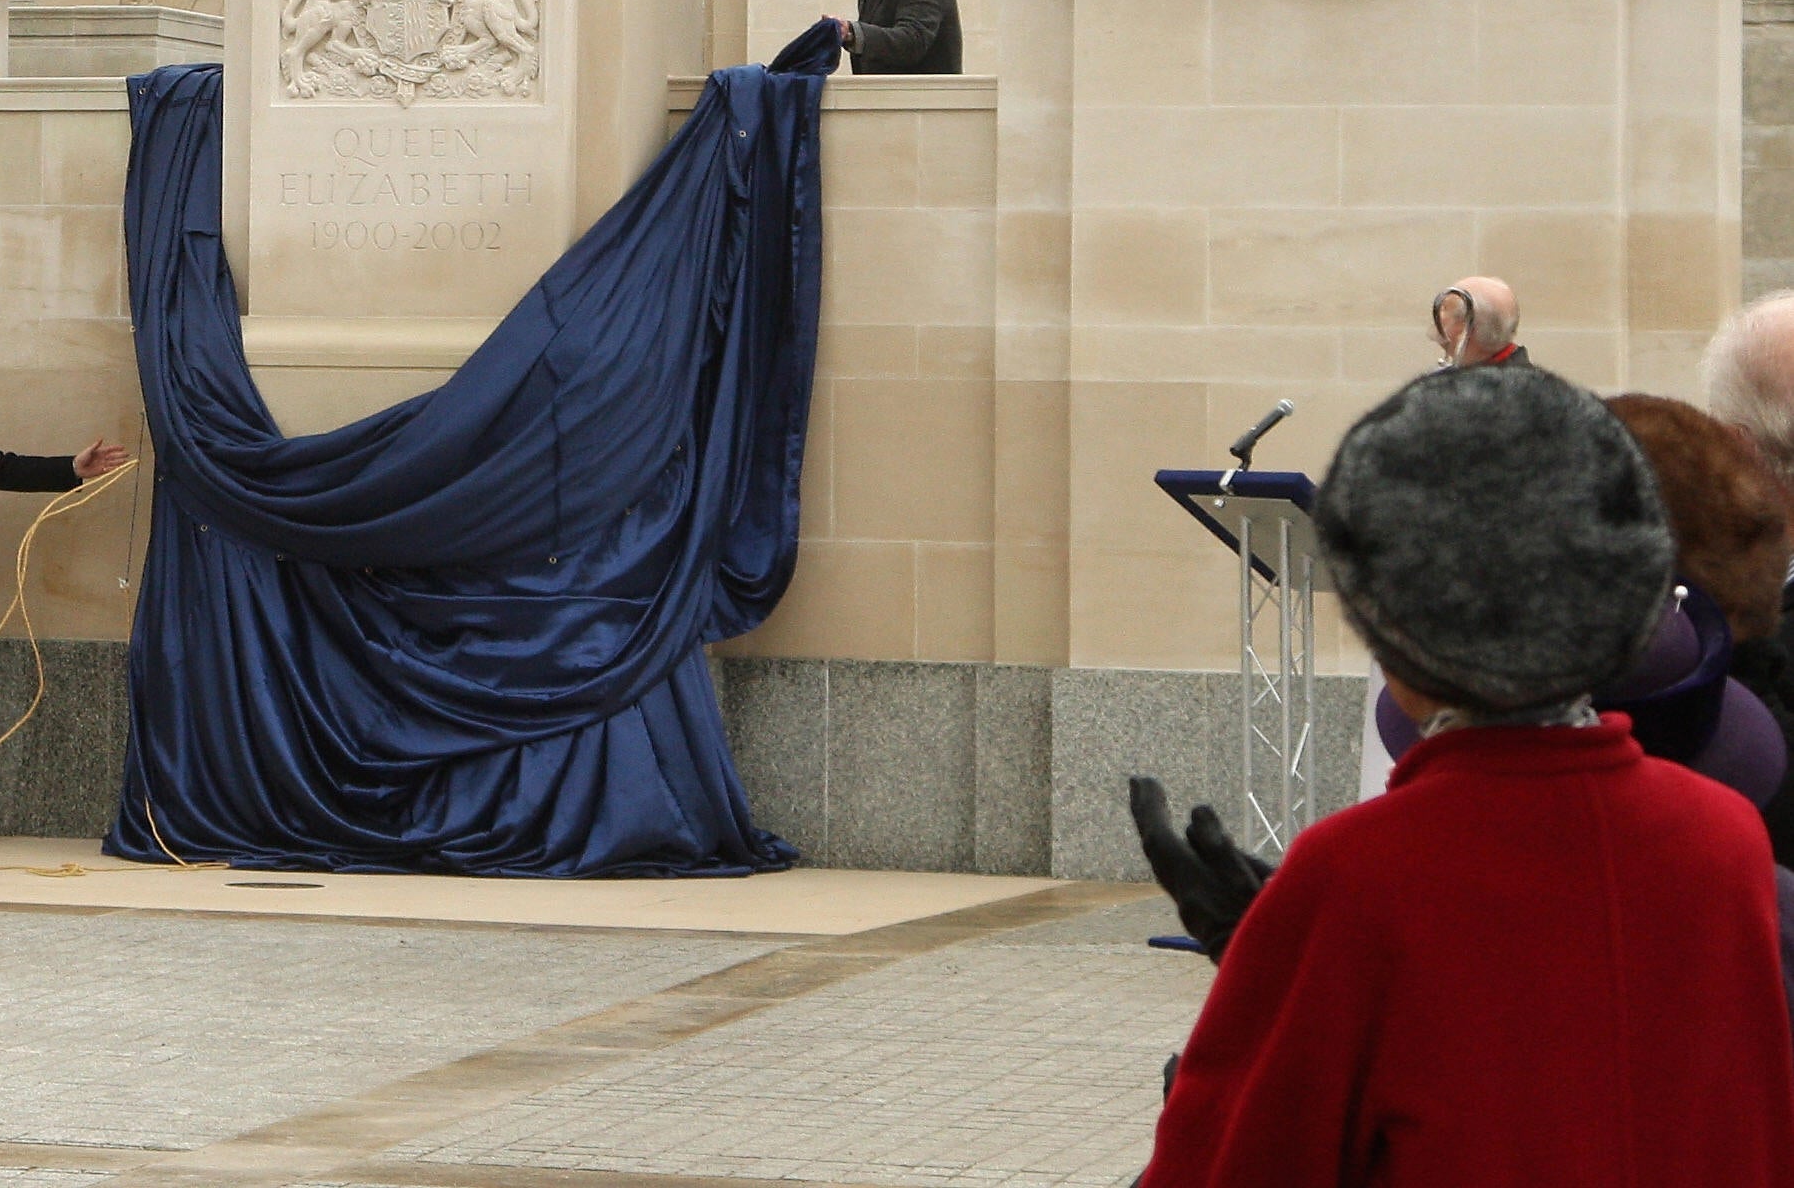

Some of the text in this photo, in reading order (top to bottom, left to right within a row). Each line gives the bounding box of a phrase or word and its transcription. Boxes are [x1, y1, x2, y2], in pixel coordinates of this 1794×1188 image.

[332, 127, 479, 166] QUEEN
[279, 172, 533, 207] ELIZABETH
[310, 220, 502, 251] 1900-2002
